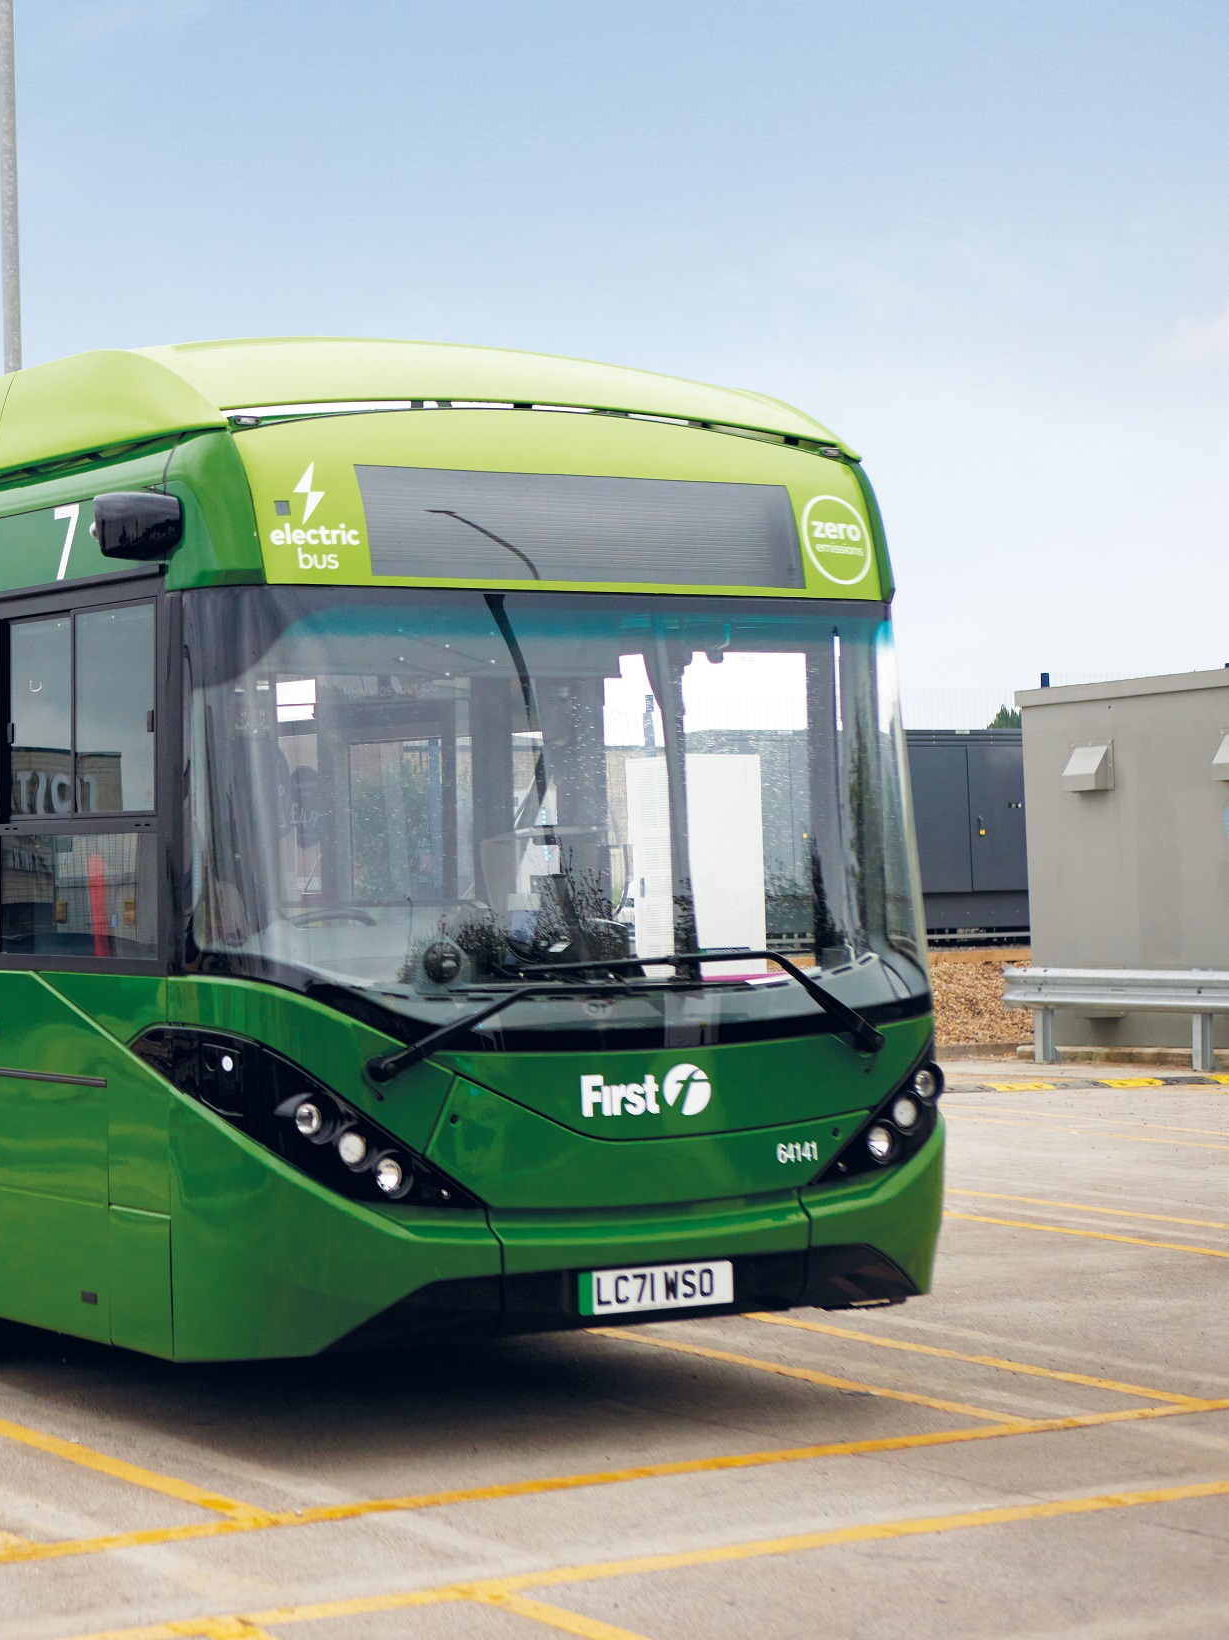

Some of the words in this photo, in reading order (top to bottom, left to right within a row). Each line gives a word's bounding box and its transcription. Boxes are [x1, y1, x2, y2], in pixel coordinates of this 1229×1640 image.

[54, 503, 80, 581] 7
[269, 522, 361, 546] electric
[810, 520, 862, 542] zero
[297, 546, 340, 570] bus
[814, 541, 865, 557] emissions
[580, 1074, 661, 1118] First
[776, 1140, 819, 1164] 64141
[596, 1272, 656, 1306] LC71
[664, 1267, 714, 1301] WSO
